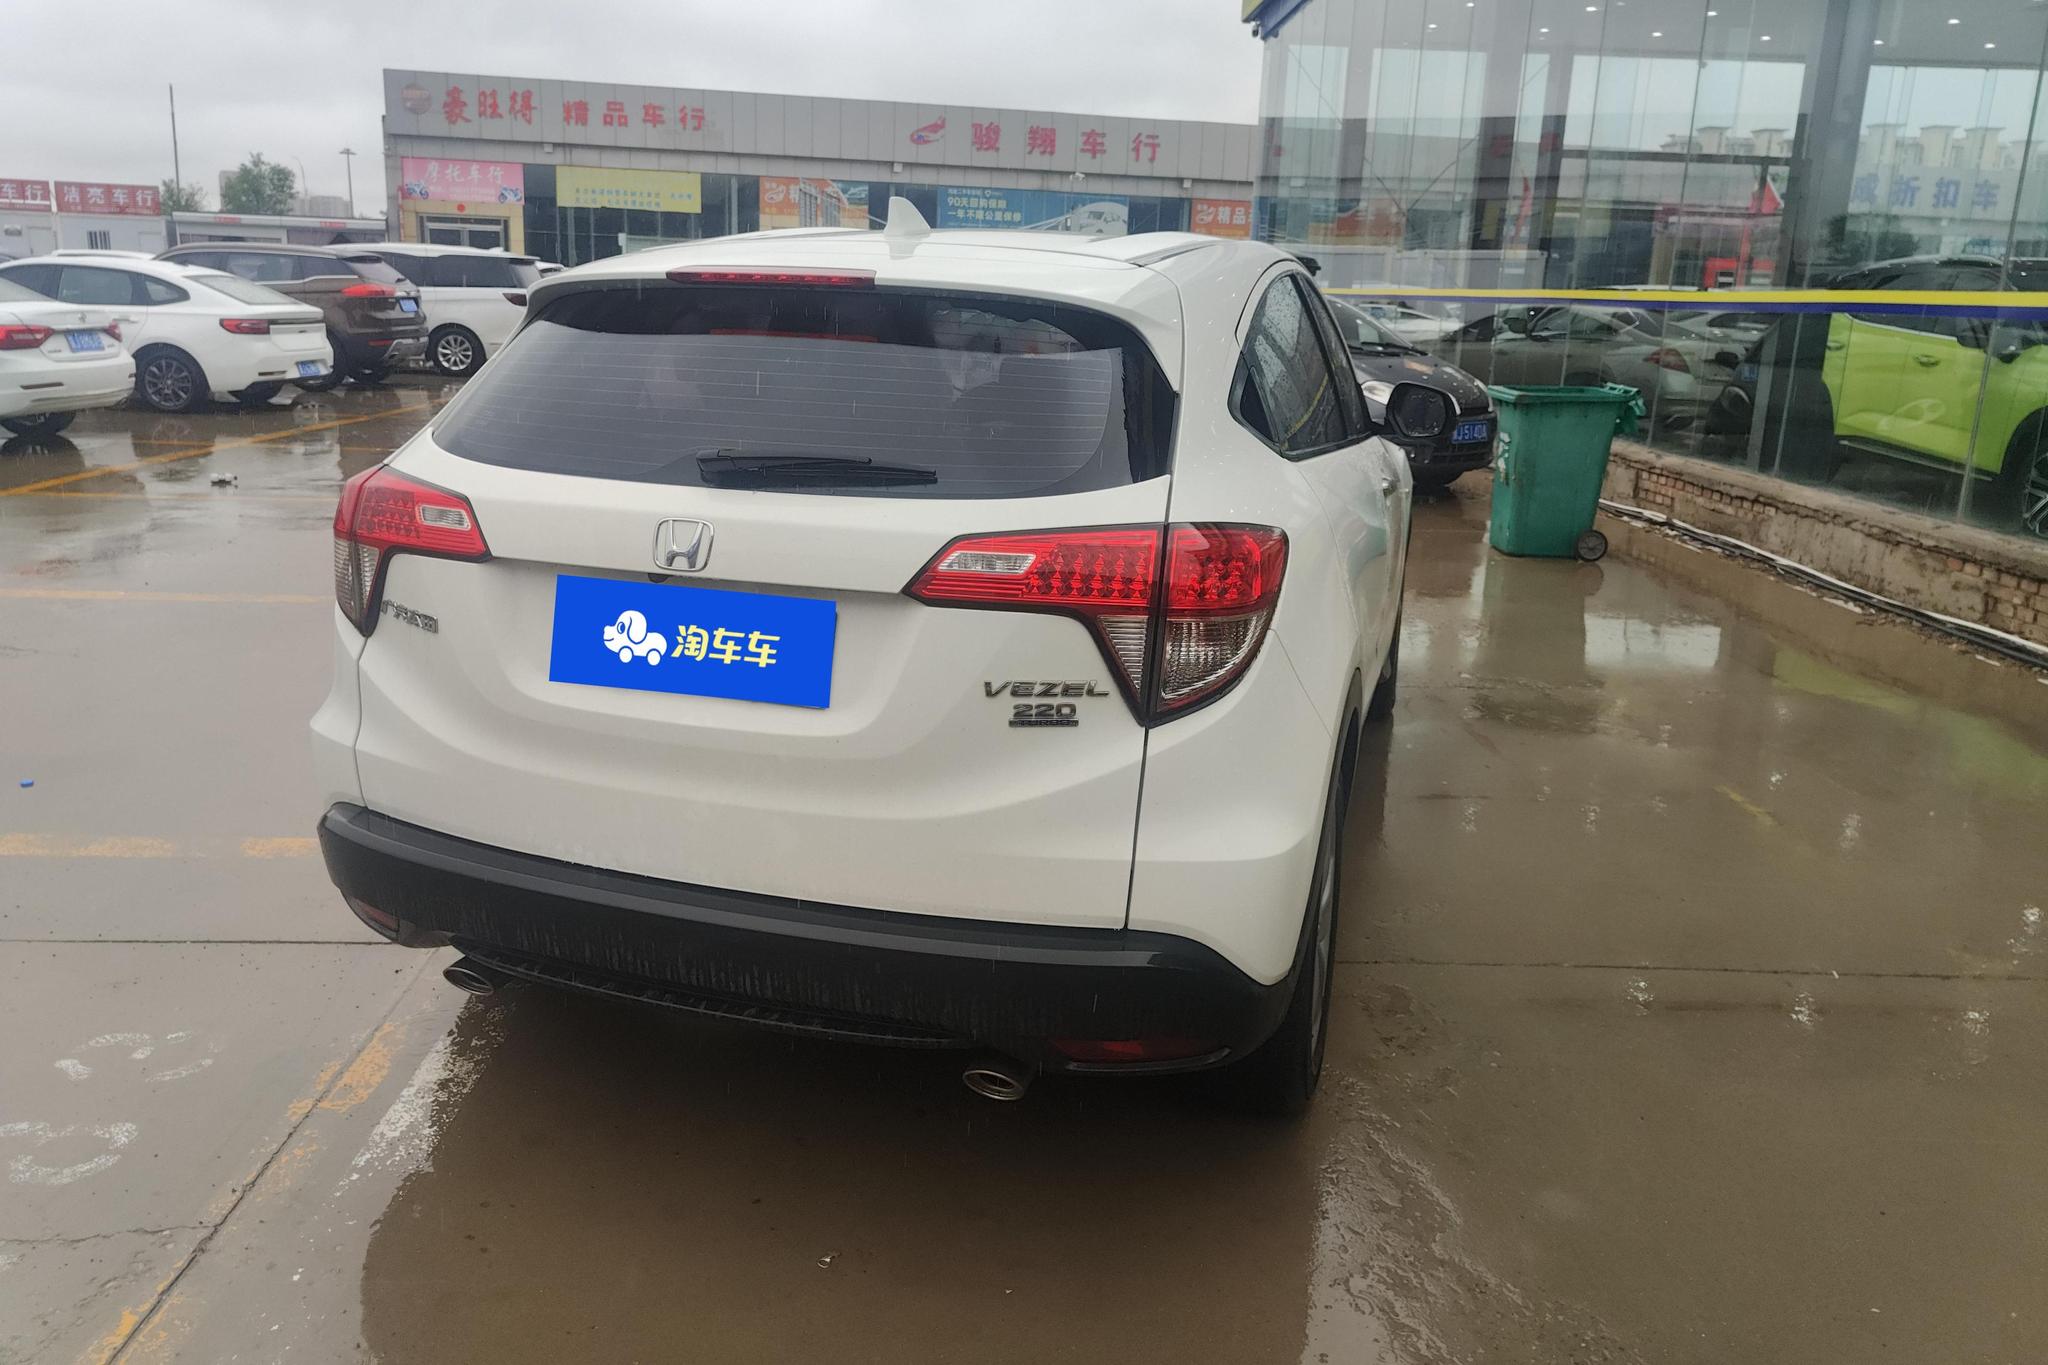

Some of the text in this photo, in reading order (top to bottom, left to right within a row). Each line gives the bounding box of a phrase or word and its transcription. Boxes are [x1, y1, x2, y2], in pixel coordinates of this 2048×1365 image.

[562, 99, 705, 132] 精品车行
[971, 121, 1161, 162] 骏翔车行
[0, 184, 43, 201] 车行
[1216, 206, 1252, 225] 精品
[984, 680, 1110, 698] VEZEL
[1013, 703, 1077, 719] 220
